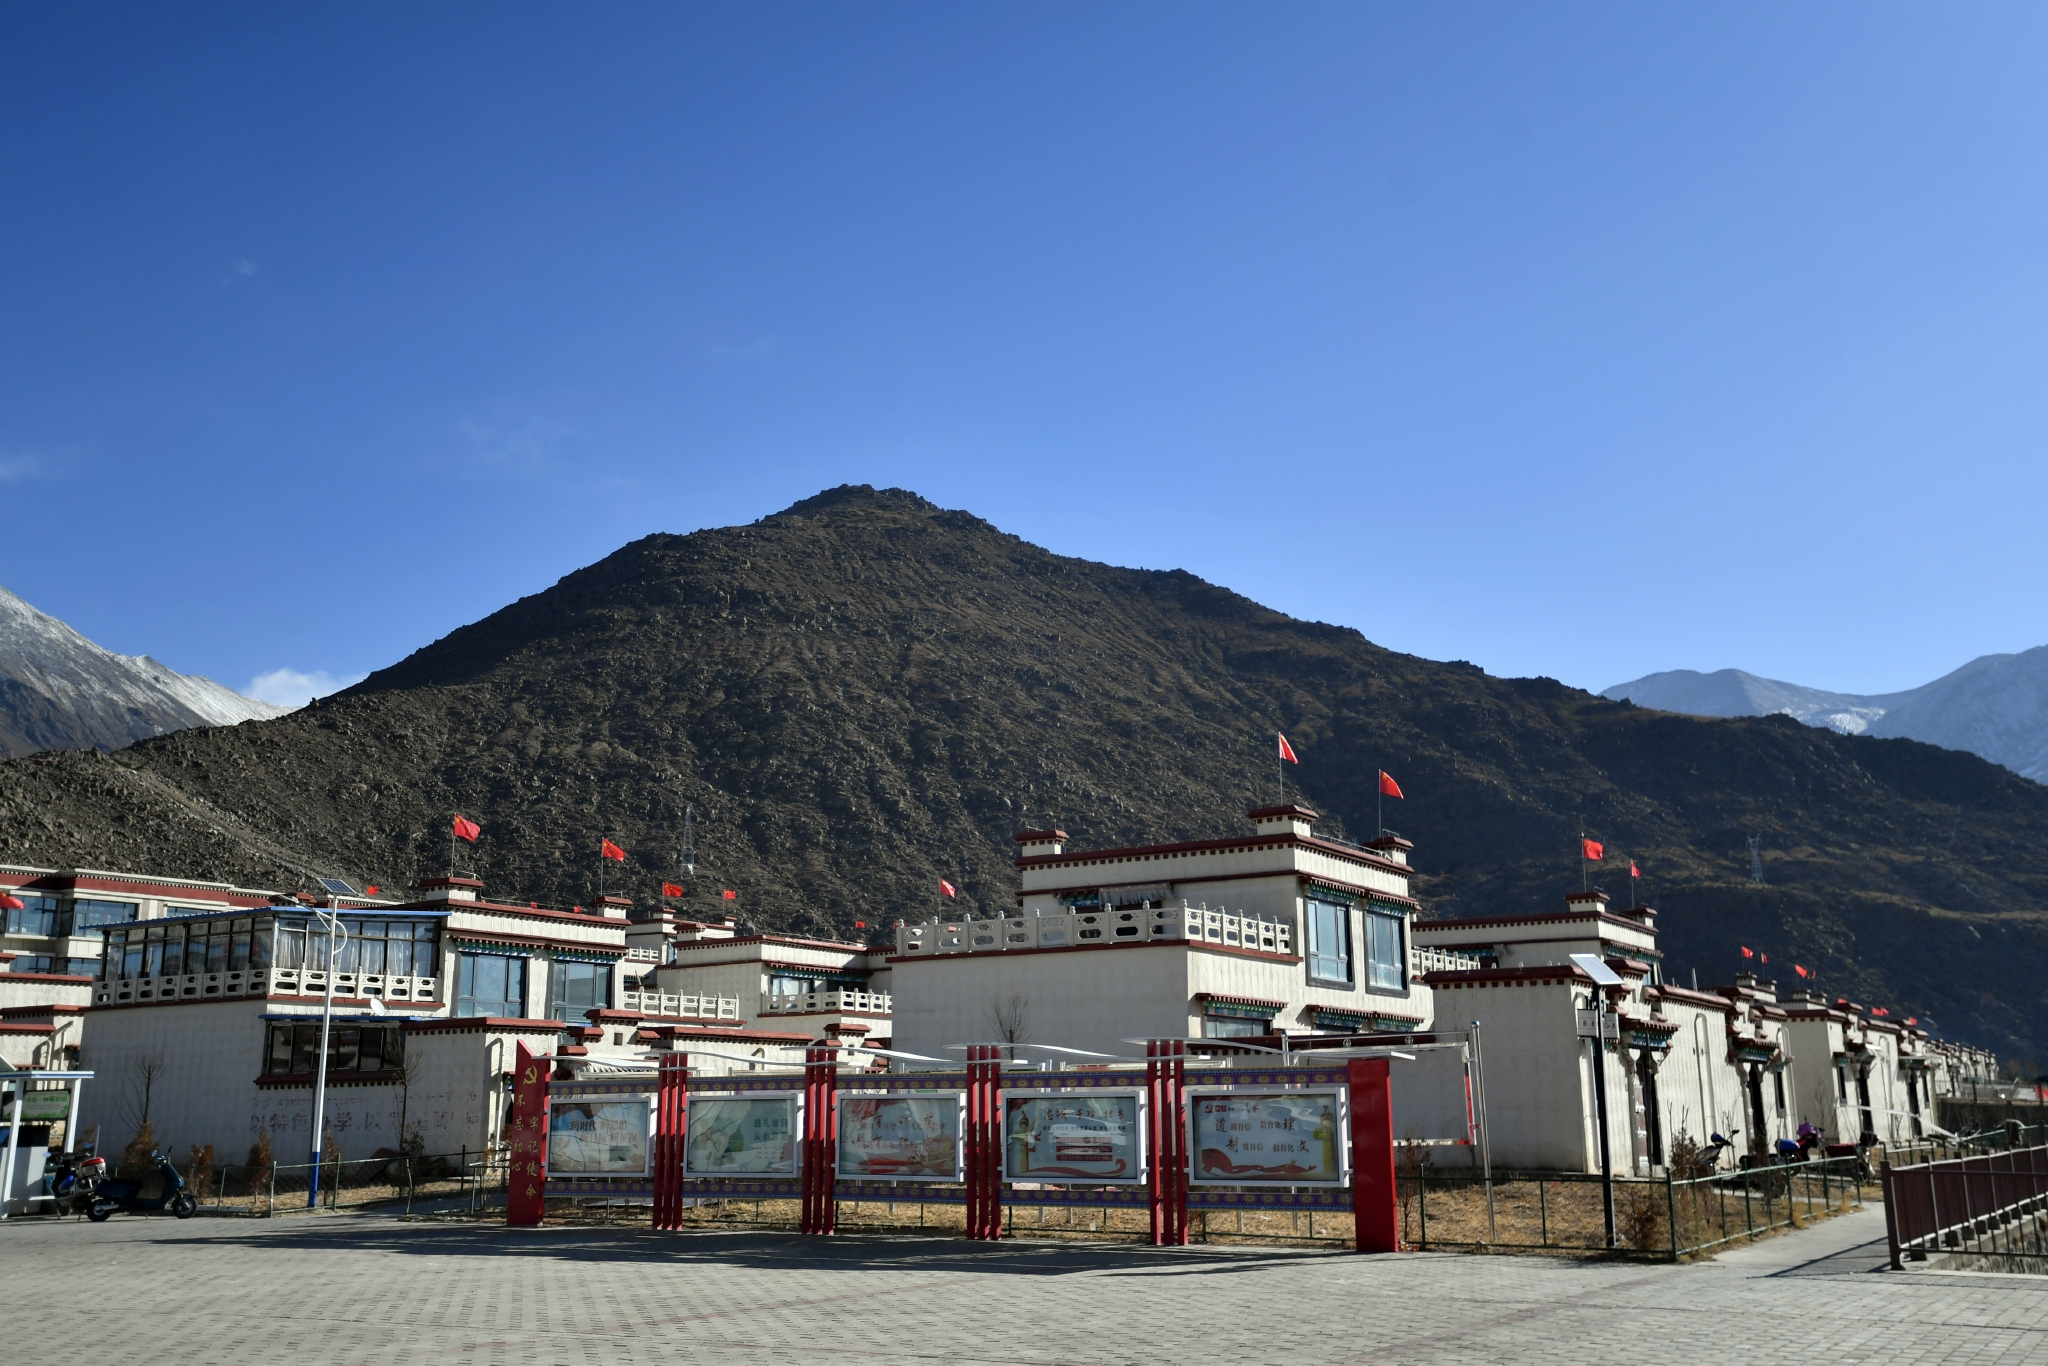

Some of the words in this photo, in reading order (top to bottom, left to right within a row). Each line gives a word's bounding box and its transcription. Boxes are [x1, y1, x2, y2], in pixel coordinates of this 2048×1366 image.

[511, 1093, 526, 1172] 不忘初心
[525, 1116, 539, 1200] 牢记使命
[569, 1118, 596, 1131] 新时代
